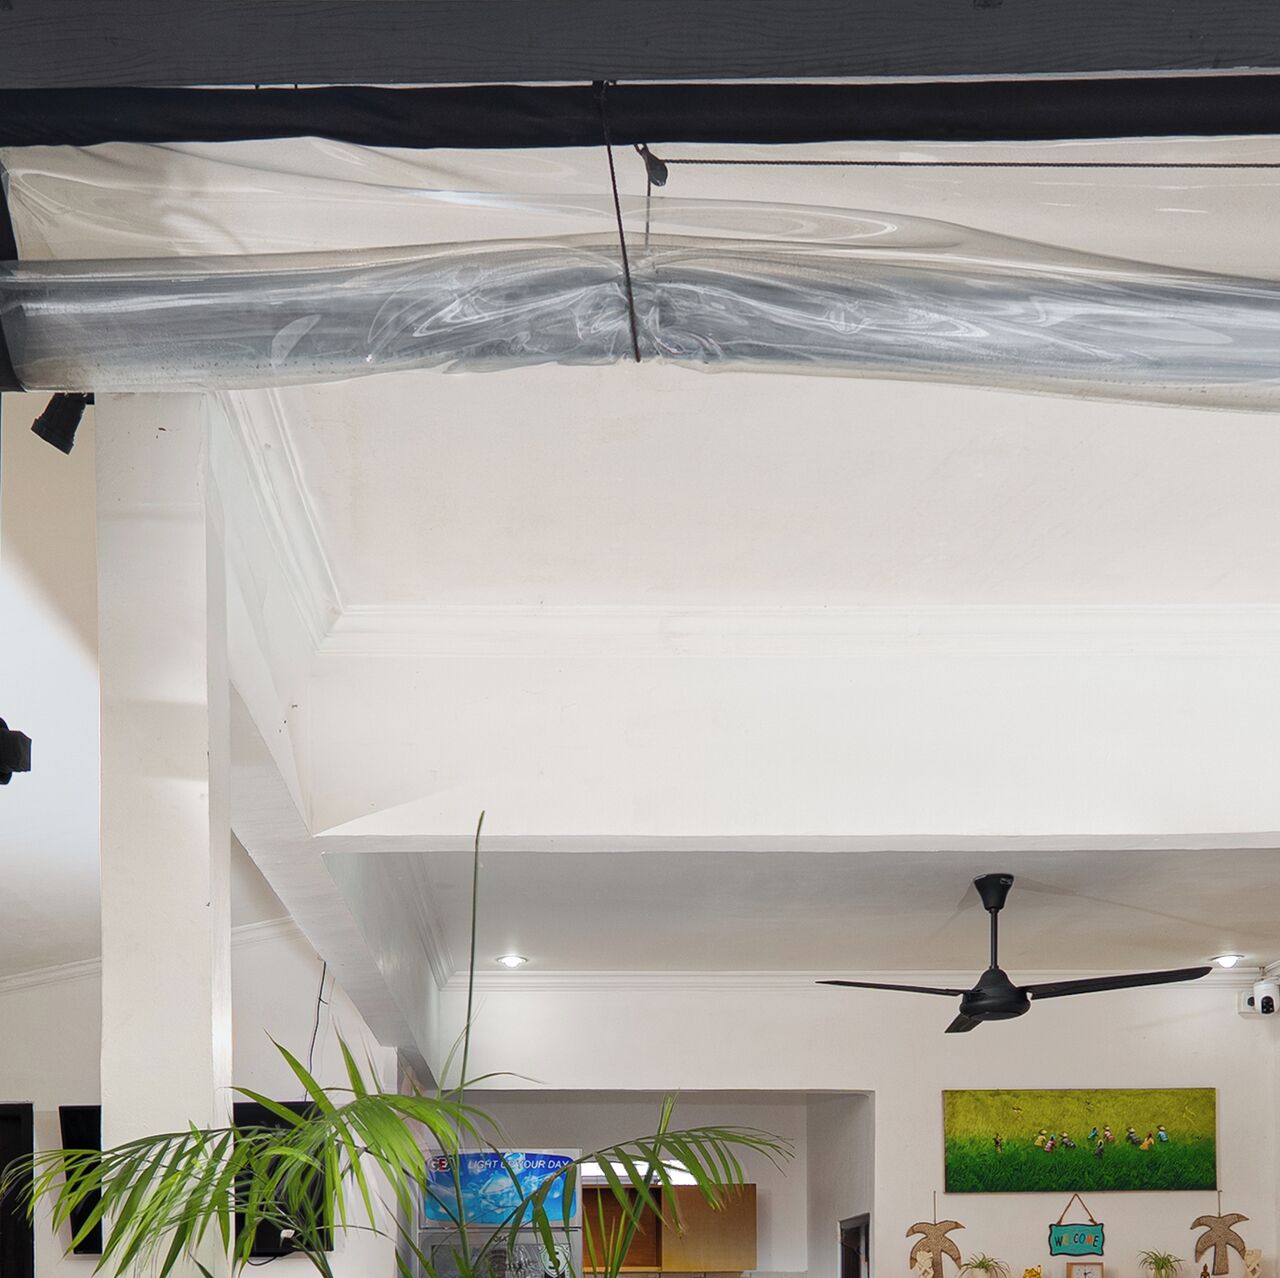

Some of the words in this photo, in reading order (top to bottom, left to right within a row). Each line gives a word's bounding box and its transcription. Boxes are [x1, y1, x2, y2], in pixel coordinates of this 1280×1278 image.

[467, 1159, 498, 1169] LIGHT
[516, 1160, 546, 1169] YOUR
[547, 1160, 570, 1169] DAY
[1054, 1232, 1100, 1247] WCOME
